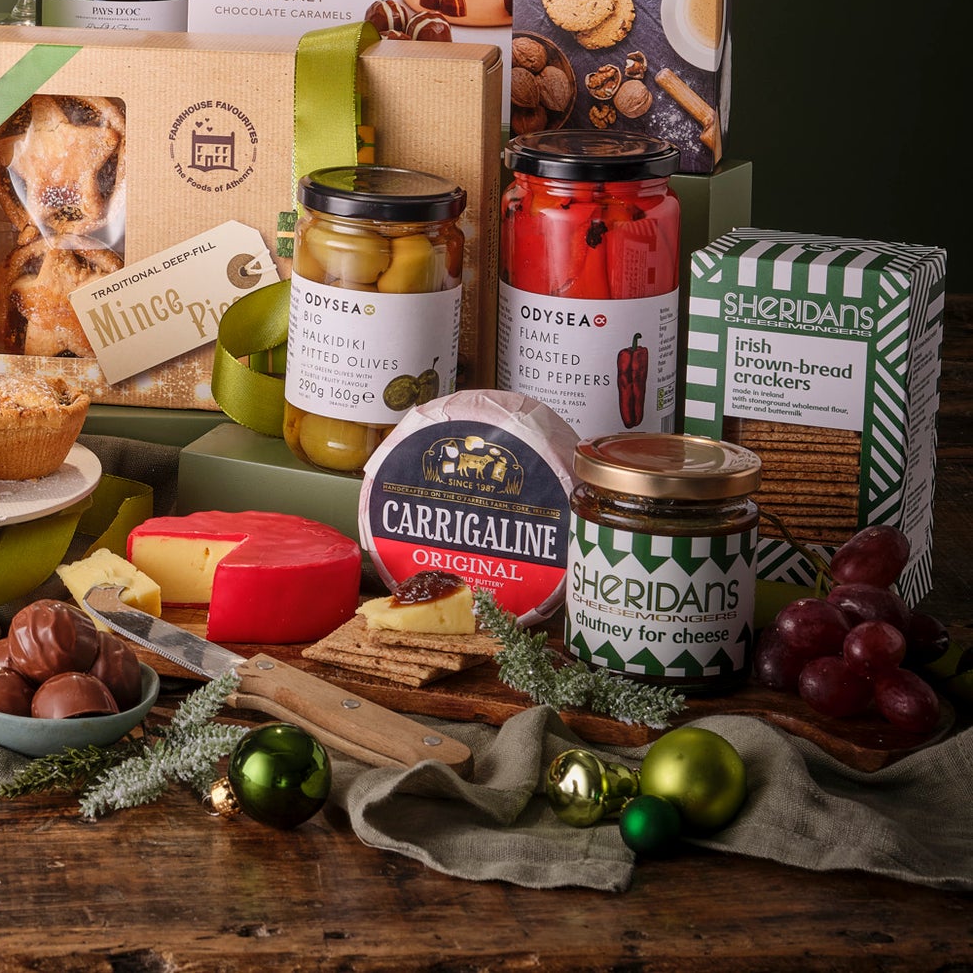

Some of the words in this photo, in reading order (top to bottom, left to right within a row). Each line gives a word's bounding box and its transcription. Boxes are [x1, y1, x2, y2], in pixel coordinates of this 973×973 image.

[92, 7, 114, 15] PAYS
[215, 6, 286, 18] CHOCOLATE
[290, 9, 352, 20] CARAMELS
[168, 100, 213, 141] FARMHOUSE
[215, 101, 259, 145] FAVOURITES
[174, 163, 186, 179] The
[187, 178, 212, 192] Foods
[214, 184, 223, 193] of
[226, 165, 254, 191] Athenry
[91, 265, 161, 301] TRADITIONAL
[162, 241, 217, 270] DEEP-FILL
[305, 292, 361, 315] ODYSEA
[86, 288, 184, 349] Mince
[304, 311, 322, 325] BIG
[521, 305, 590, 327] ODYSEA
[724, 315, 873, 337] CHEESEMONGERS
[303, 328, 365, 350] HALKIDIKI
[519, 327, 559, 345] FLAME
[735, 336, 772, 355] irish
[301, 345, 339, 364] PITTED
[347, 356, 398, 370] OLIVES
[519, 346, 581, 366] ROASTED
[734, 351, 853, 380] brown-bread
[519, 365, 539, 380] RED
[548, 371, 610, 386] PEPPERS
[733, 371, 811, 391] crackers
[298, 378, 324, 398] 290g
[330, 387, 360, 404] 160g
[732, 387, 751, 395] made
[761, 390, 784, 399] ireland
[732, 395, 747, 403] with
[748, 397, 790, 408] stoneground
[792, 401, 829, 412] wholemeal
[732, 403, 752, 411] butter
[753, 405, 767, 413] and
[768, 407, 802, 417] buttermilk
[383, 484, 429, 497] HANDCRAFTED
[448, 478, 473, 490] SINCE
[477, 483, 496, 492] 1987
[382, 500, 557, 560] CARRIGALINE
[412, 548, 523, 582] ORIGINAL
[572, 593, 738, 623] CHEESEMONGERS
[576, 610, 633, 642] chutney
[639, 625, 666, 643] for
[673, 628, 729, 644] cheese
